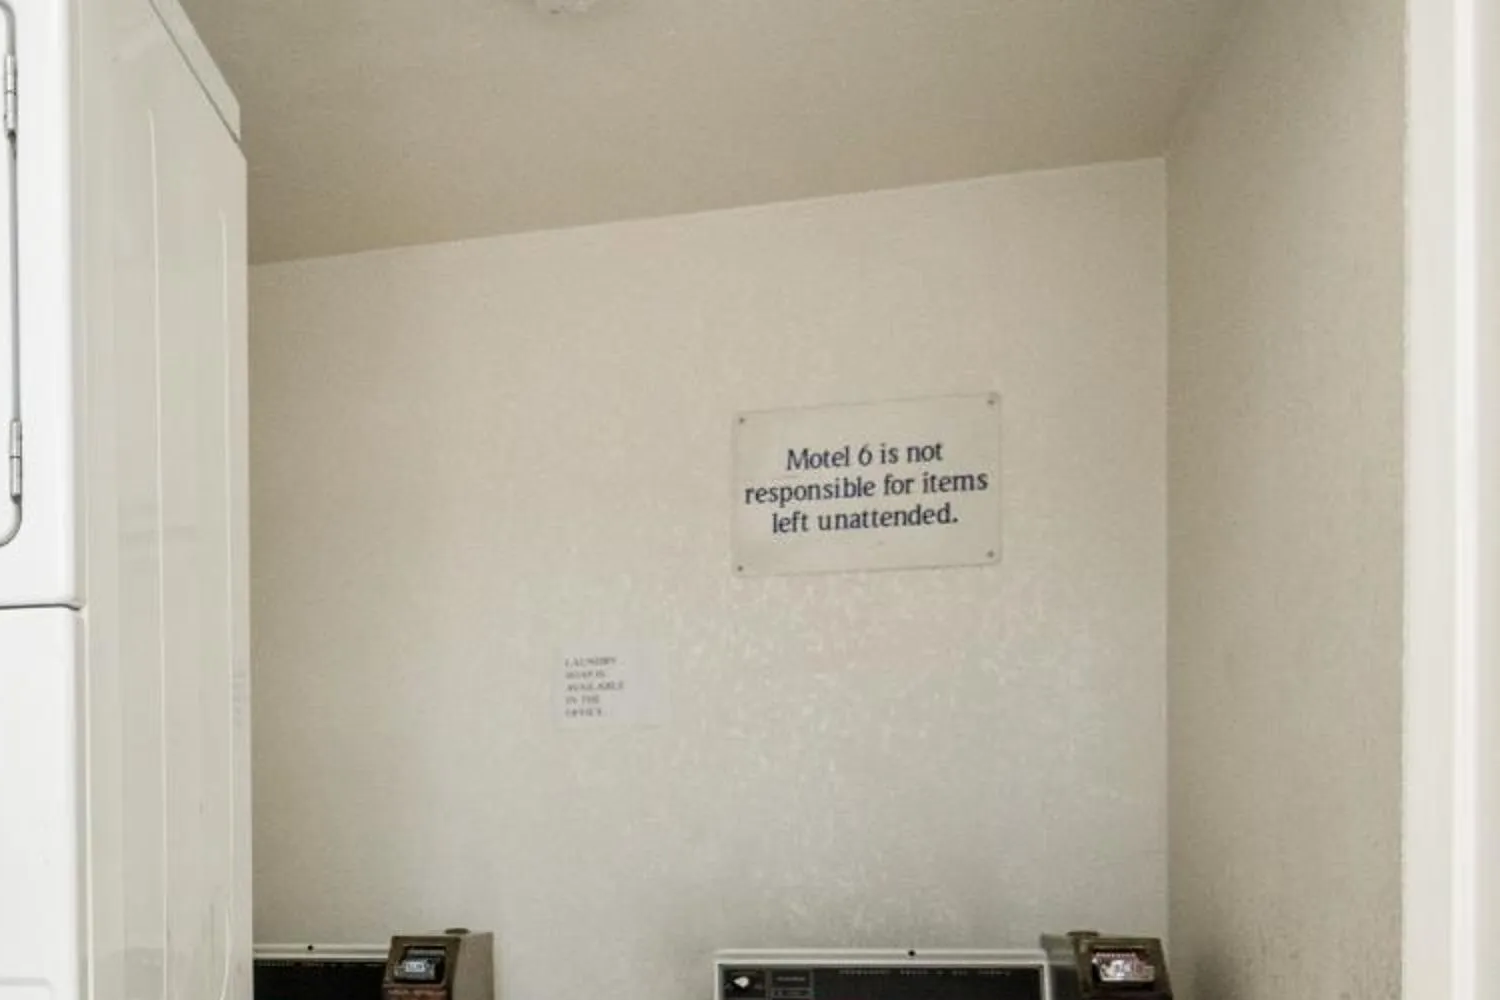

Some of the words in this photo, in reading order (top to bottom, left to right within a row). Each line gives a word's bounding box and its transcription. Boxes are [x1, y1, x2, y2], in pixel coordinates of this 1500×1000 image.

[787, 446, 850, 470] Motel
[858, 444, 873, 467] 6
[881, 444, 899, 464] is
[907, 442, 944, 462] not
[744, 476, 877, 508] responsible
[883, 473, 914, 495] for
[922, 470, 989, 494] items
[772, 511, 809, 534] left
[818, 503, 959, 531] unattended.
